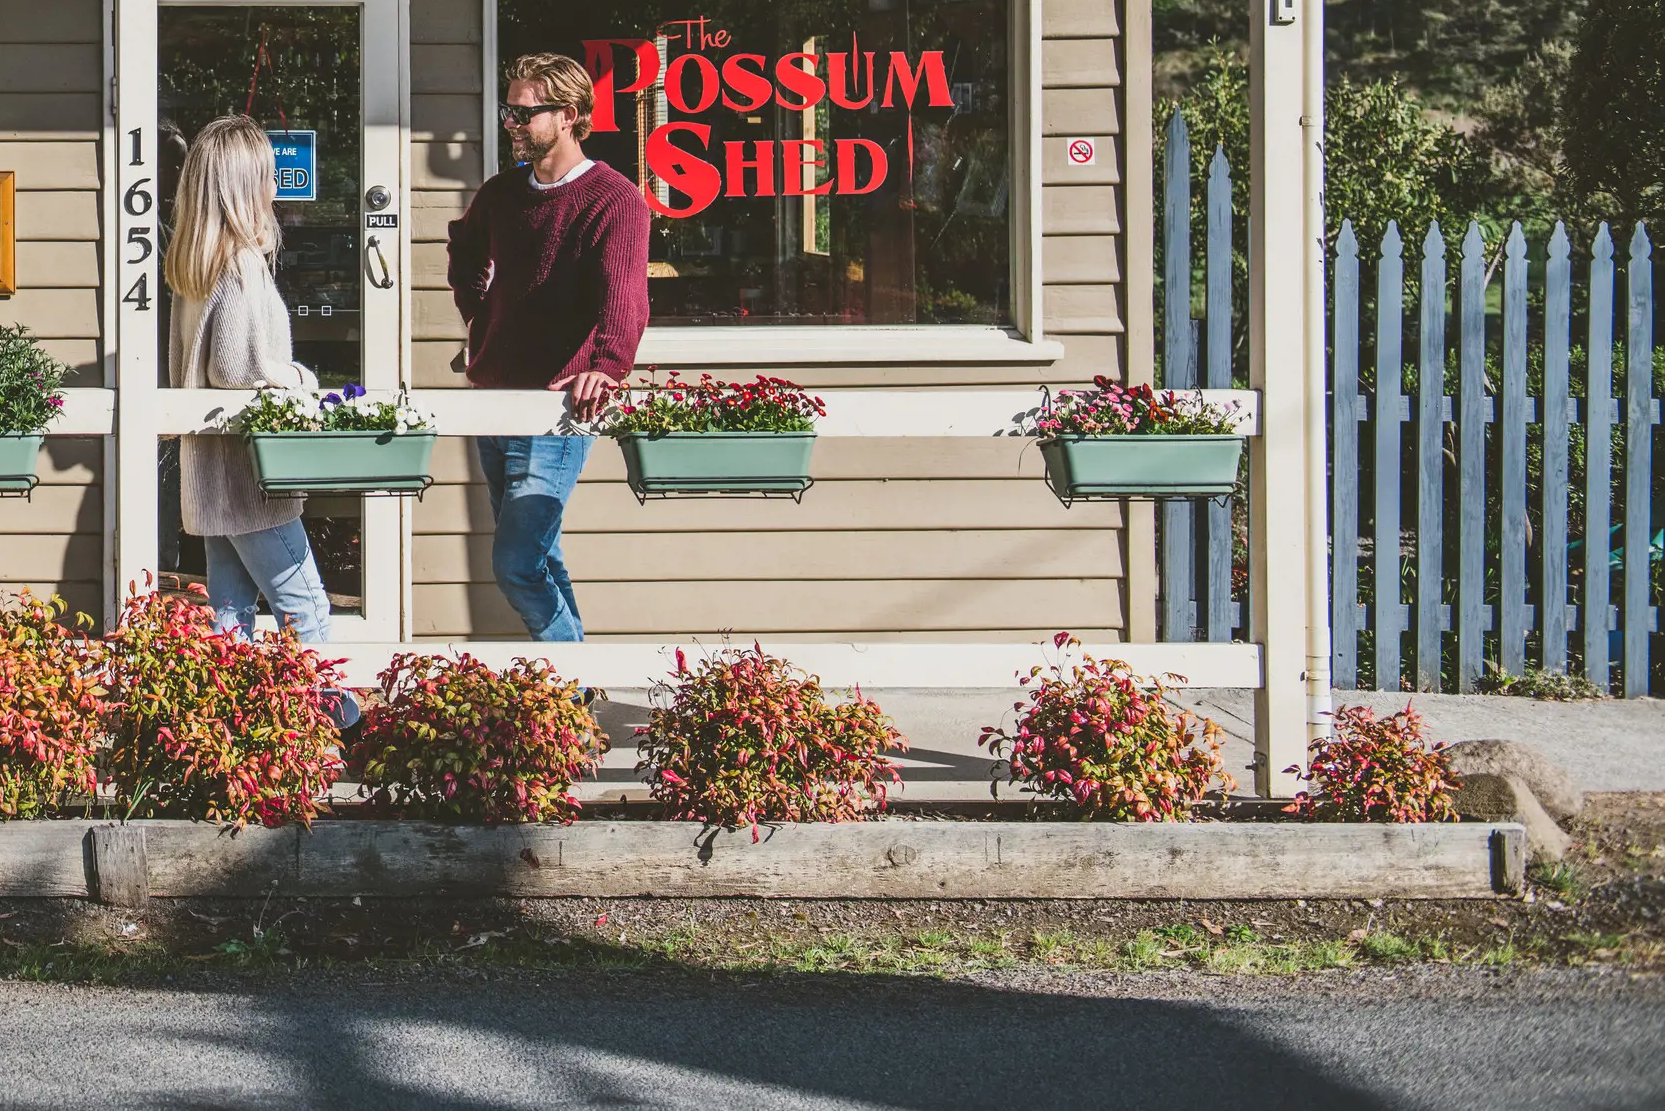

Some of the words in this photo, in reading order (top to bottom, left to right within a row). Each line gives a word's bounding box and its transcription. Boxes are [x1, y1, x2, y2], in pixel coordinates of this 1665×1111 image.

[656, 15, 731, 50] The
[582, 31, 955, 182] POSSUM
[281, 147, 298, 156] ARE
[646, 121, 889, 220] SHED
[122, 127, 153, 311] 1654
[369, 216, 396, 227] PULL
